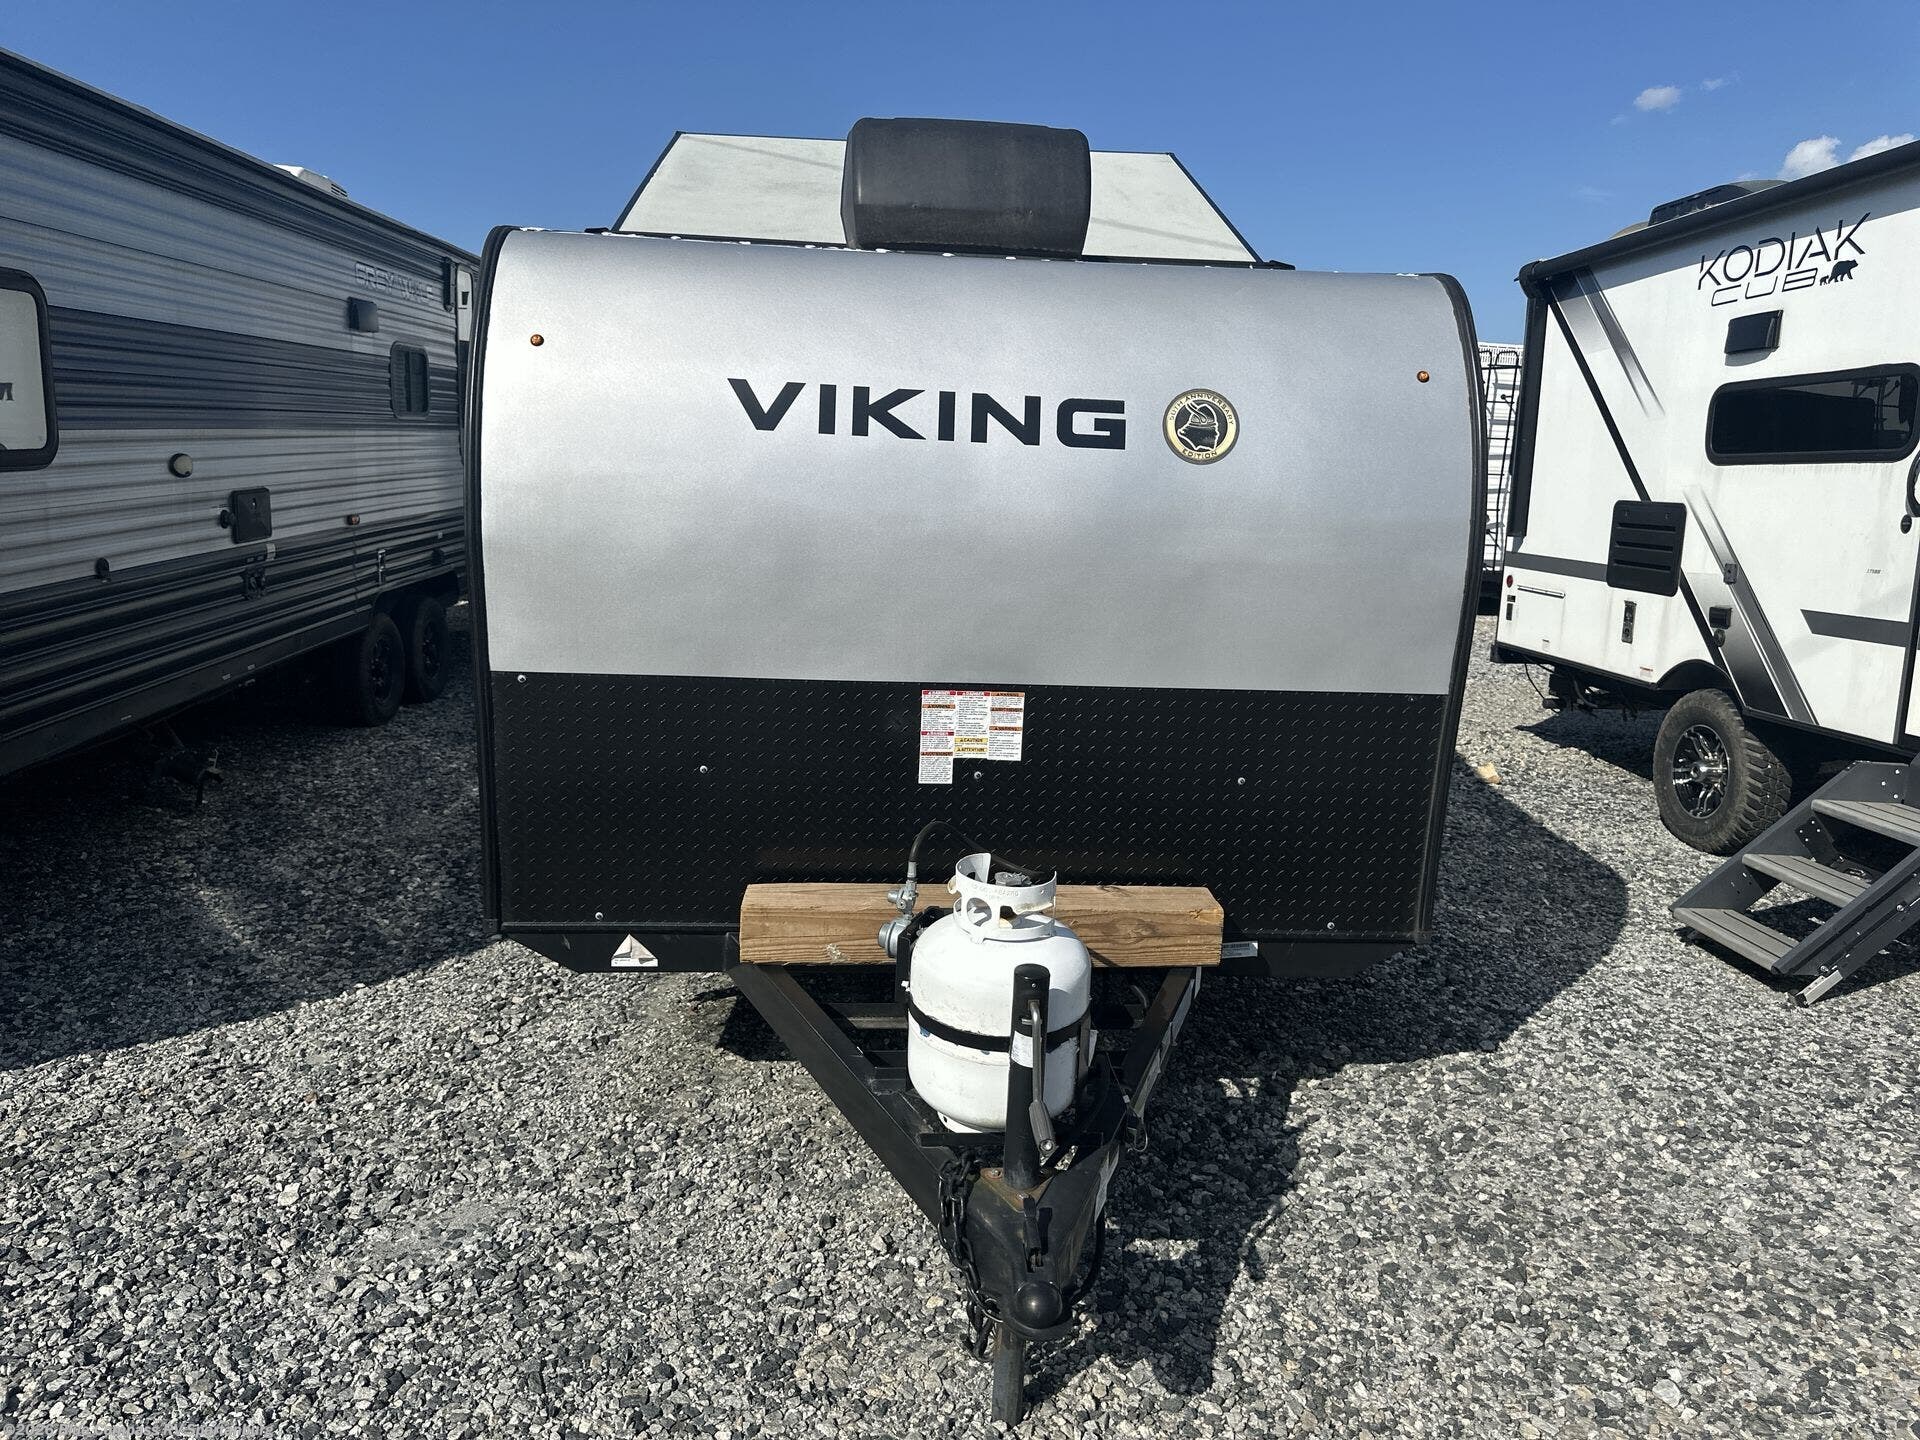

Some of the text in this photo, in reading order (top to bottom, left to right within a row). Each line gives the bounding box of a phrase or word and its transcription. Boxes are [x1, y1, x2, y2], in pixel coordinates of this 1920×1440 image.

[1698, 212, 1871, 290] KODIAK
[1711, 267, 1818, 307] CUB
[727, 377, 1127, 450] VIKING
[1185, 392, 1234, 425] ANNIVERSARY
[1182, 449, 1218, 459] EDITION
